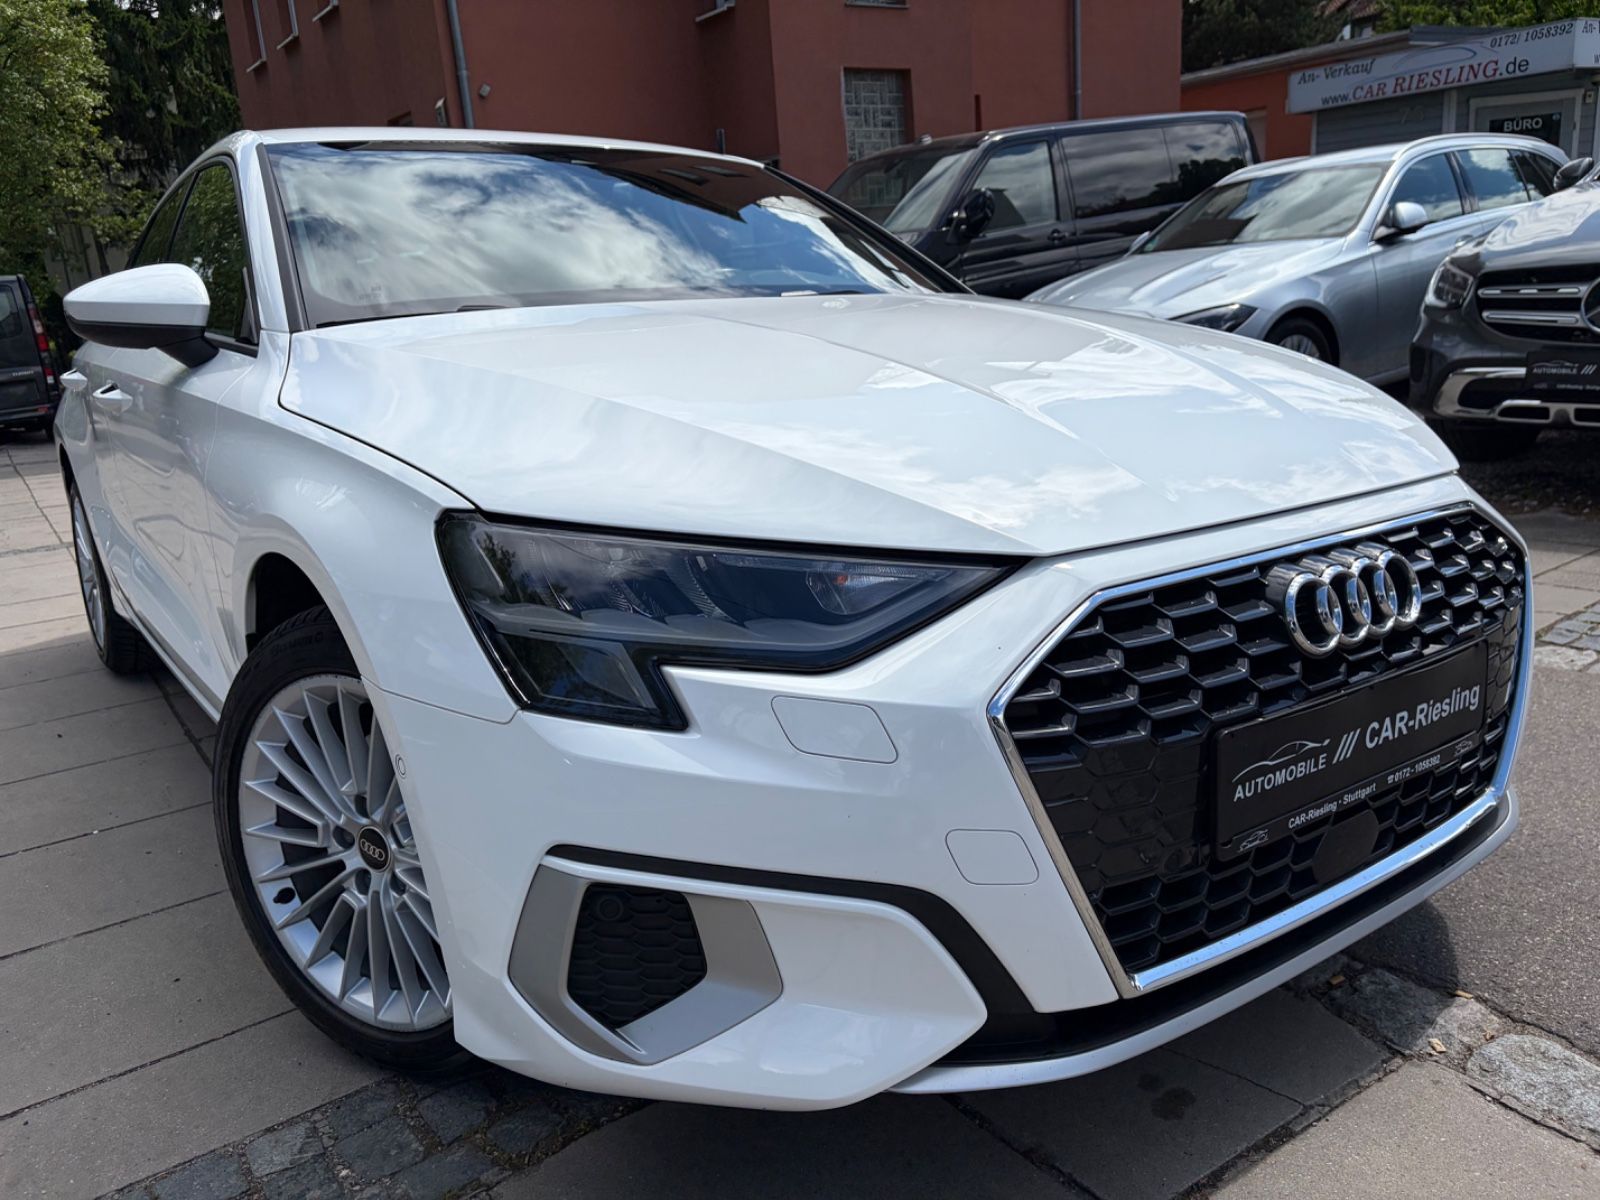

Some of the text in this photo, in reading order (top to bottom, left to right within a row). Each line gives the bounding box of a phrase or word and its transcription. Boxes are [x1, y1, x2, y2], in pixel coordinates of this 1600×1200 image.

[1525, 22, 1573, 42] 1058392
[1298, 58, 1376, 85] An- Verkauf
[1392, 56, 1529, 94] RIESLING.de
[1503, 117, 1543, 132] BÜRO
[1233, 684, 1480, 802] AUTOMOBILE CAR-Riesling
[1288, 800, 1337, 829] CAR-Riesling
[1343, 782, 1377, 806] Stuttgart
